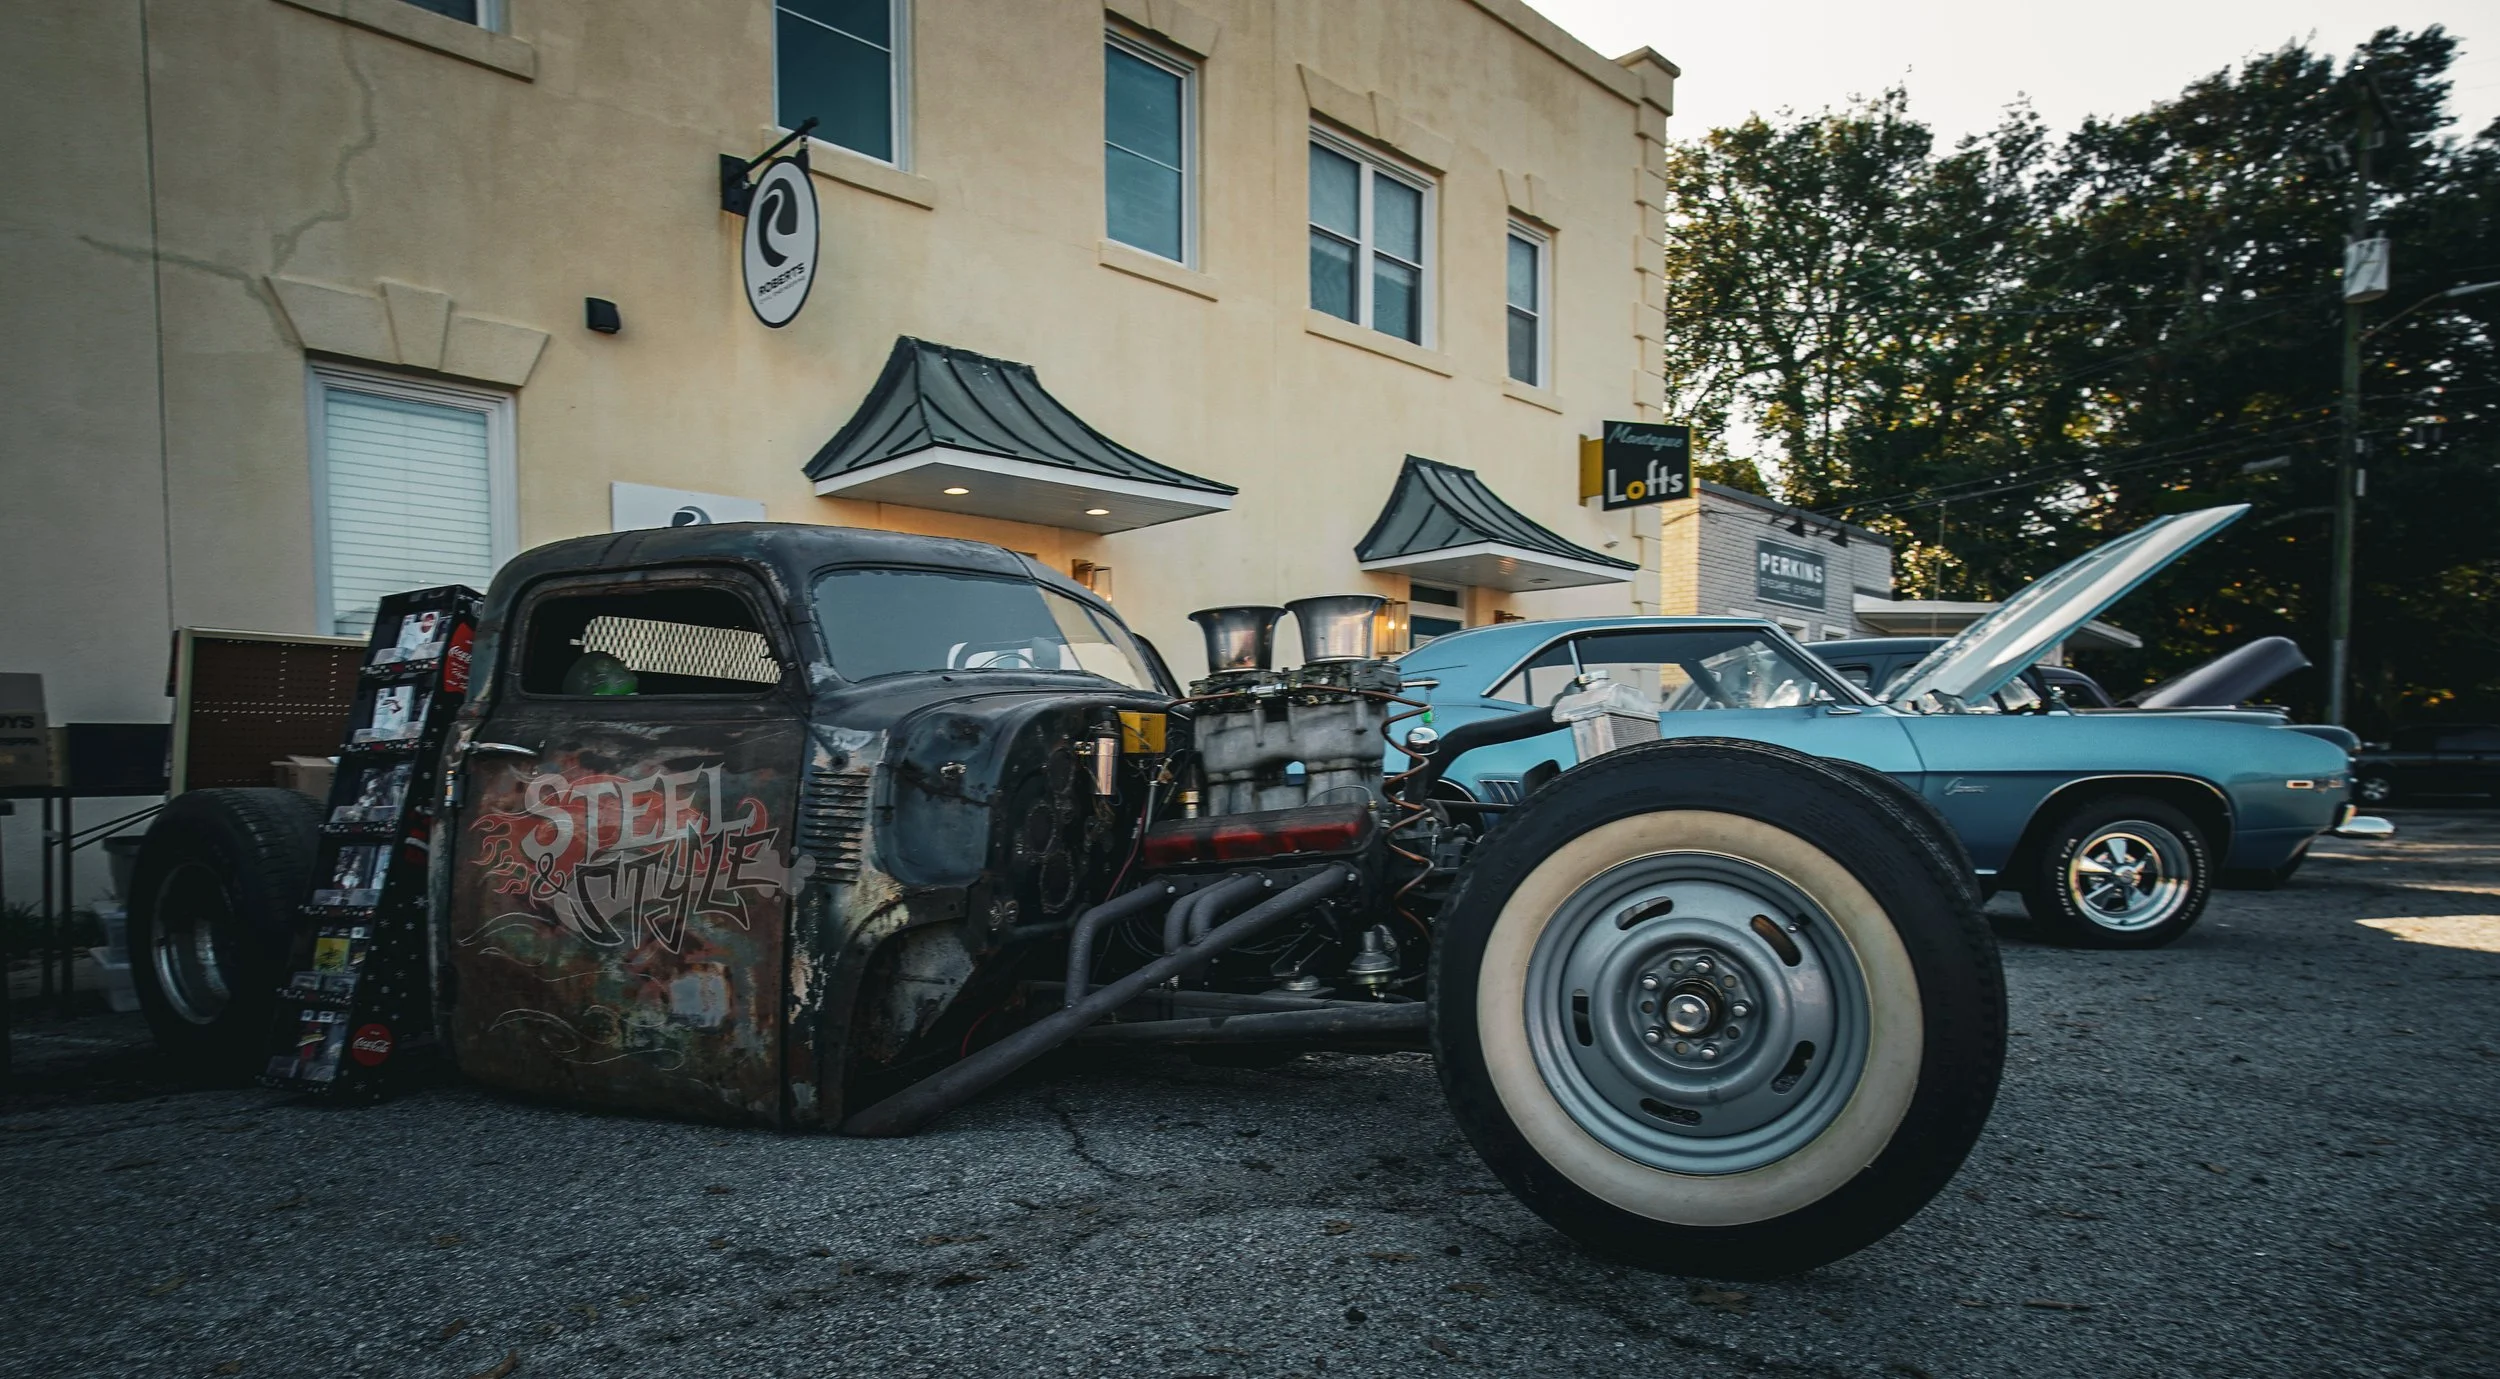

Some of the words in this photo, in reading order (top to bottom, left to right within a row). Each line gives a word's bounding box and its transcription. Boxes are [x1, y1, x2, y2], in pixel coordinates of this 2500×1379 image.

[758, 262, 804, 296] ROBERTS
[1607, 459, 1684, 503] Lofts
[1760, 552, 1823, 584] PERKINS
[520, 762, 756, 864] STEEL
[529, 852, 569, 909] &
[567, 822, 781, 954] STYLE
